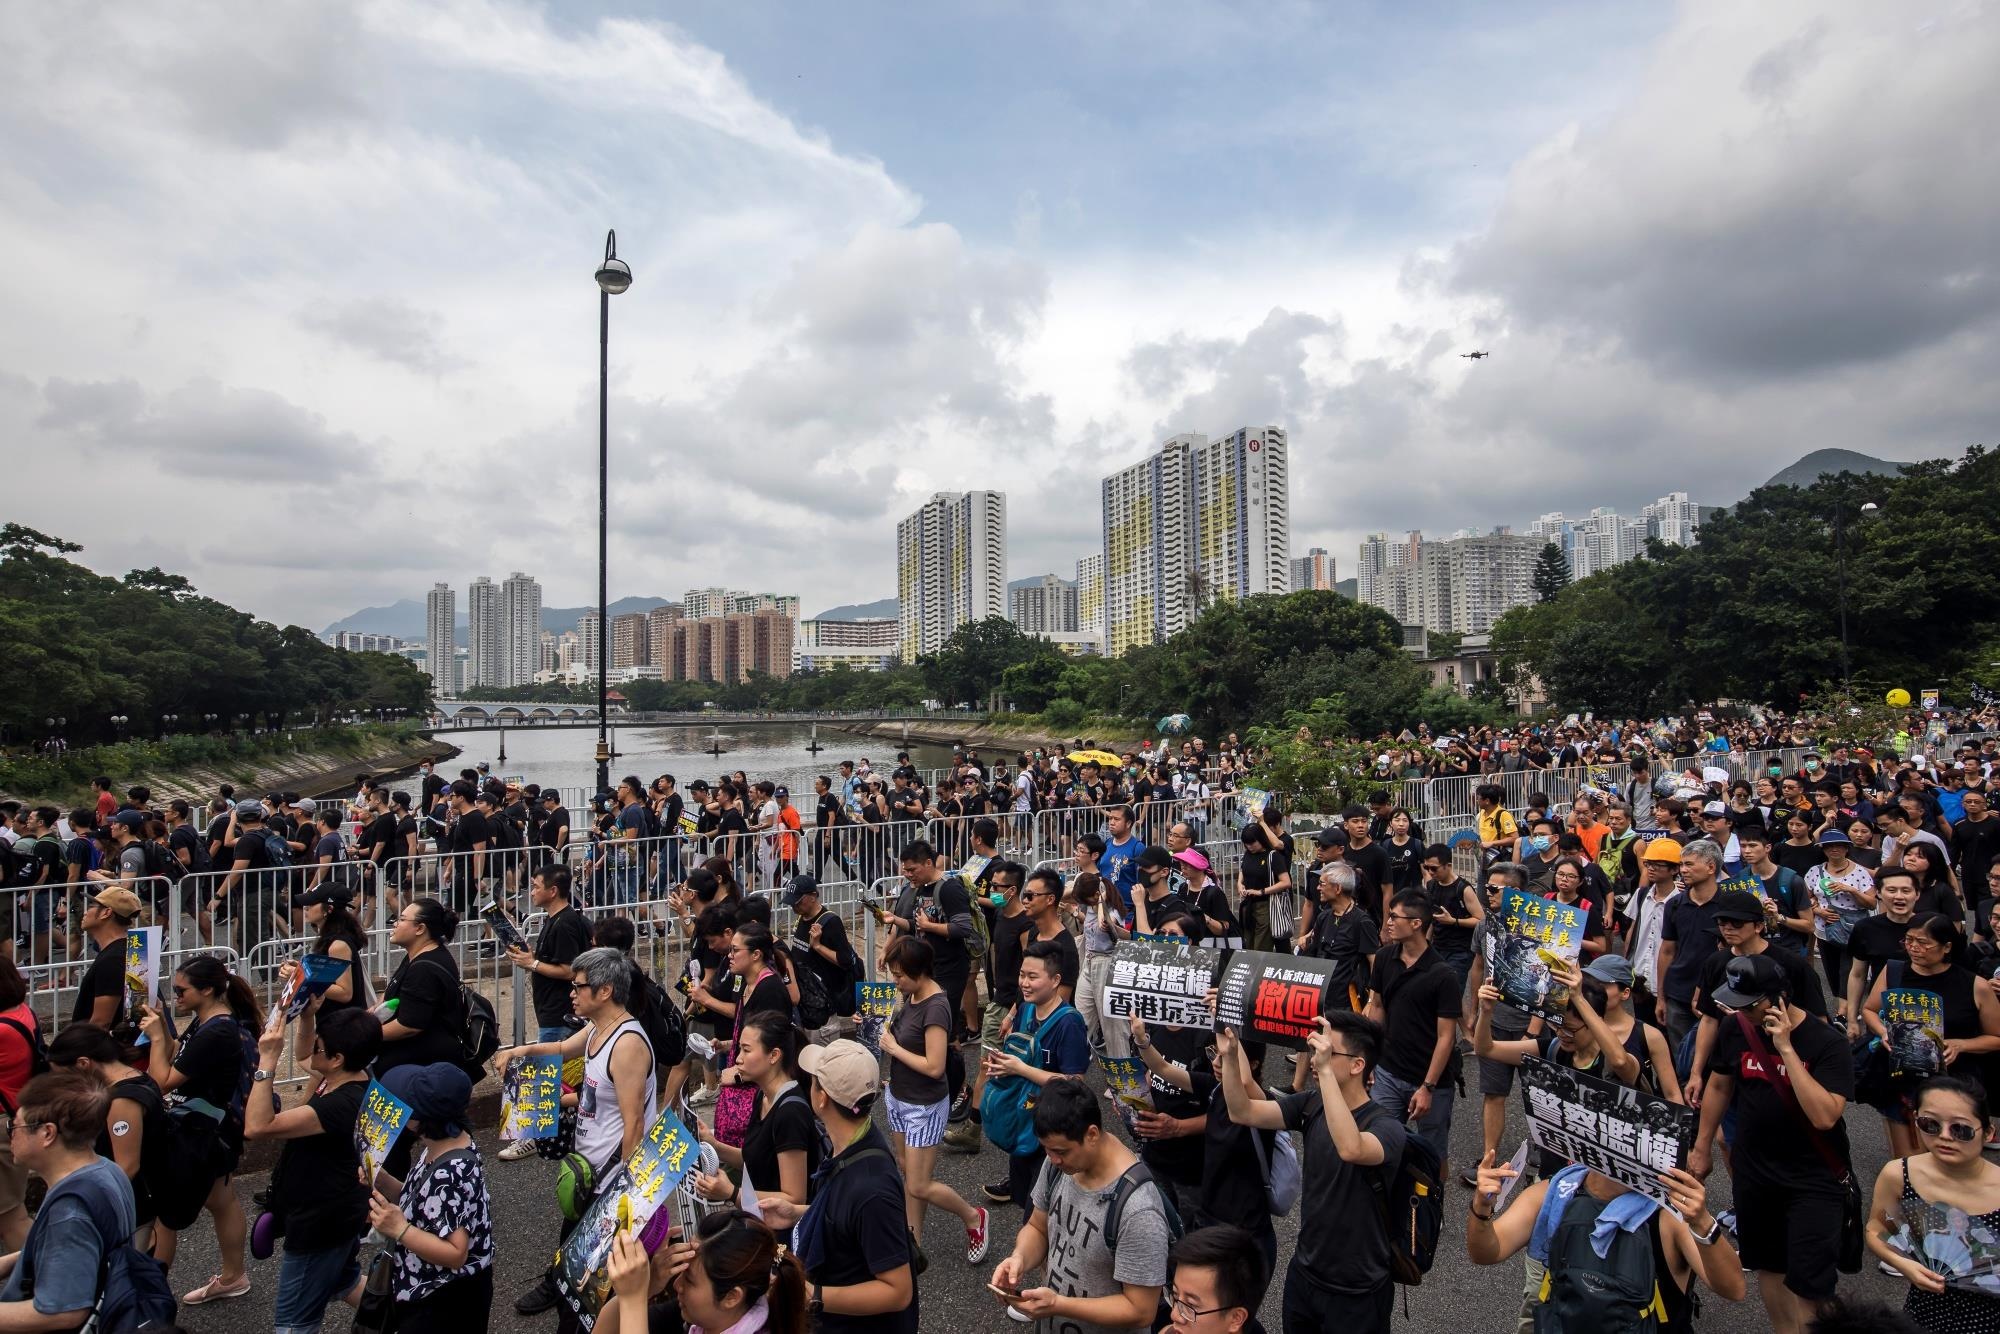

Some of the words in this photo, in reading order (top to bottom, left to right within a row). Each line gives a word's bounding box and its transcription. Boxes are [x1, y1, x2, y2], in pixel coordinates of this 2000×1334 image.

[1509, 894, 1580, 928] 守住香港
[1506, 915, 1572, 948] 守住善良
[1112, 959, 1212, 997] 警察濫權
[1262, 966, 1326, 986] 港人訴求清晰
[1109, 990, 1212, 1027] 香港玩完
[1254, 979, 1321, 1026] 撤回
[1887, 992, 1942, 1011] 守住香港
[368, 1088, 403, 1130] 守住香港
[516, 1064, 537, 1131] 守住善良
[536, 1063, 559, 1133] 守住香港
[360, 1111, 389, 1152] 守住善良
[1527, 1085, 1680, 1175] 警察濫權
